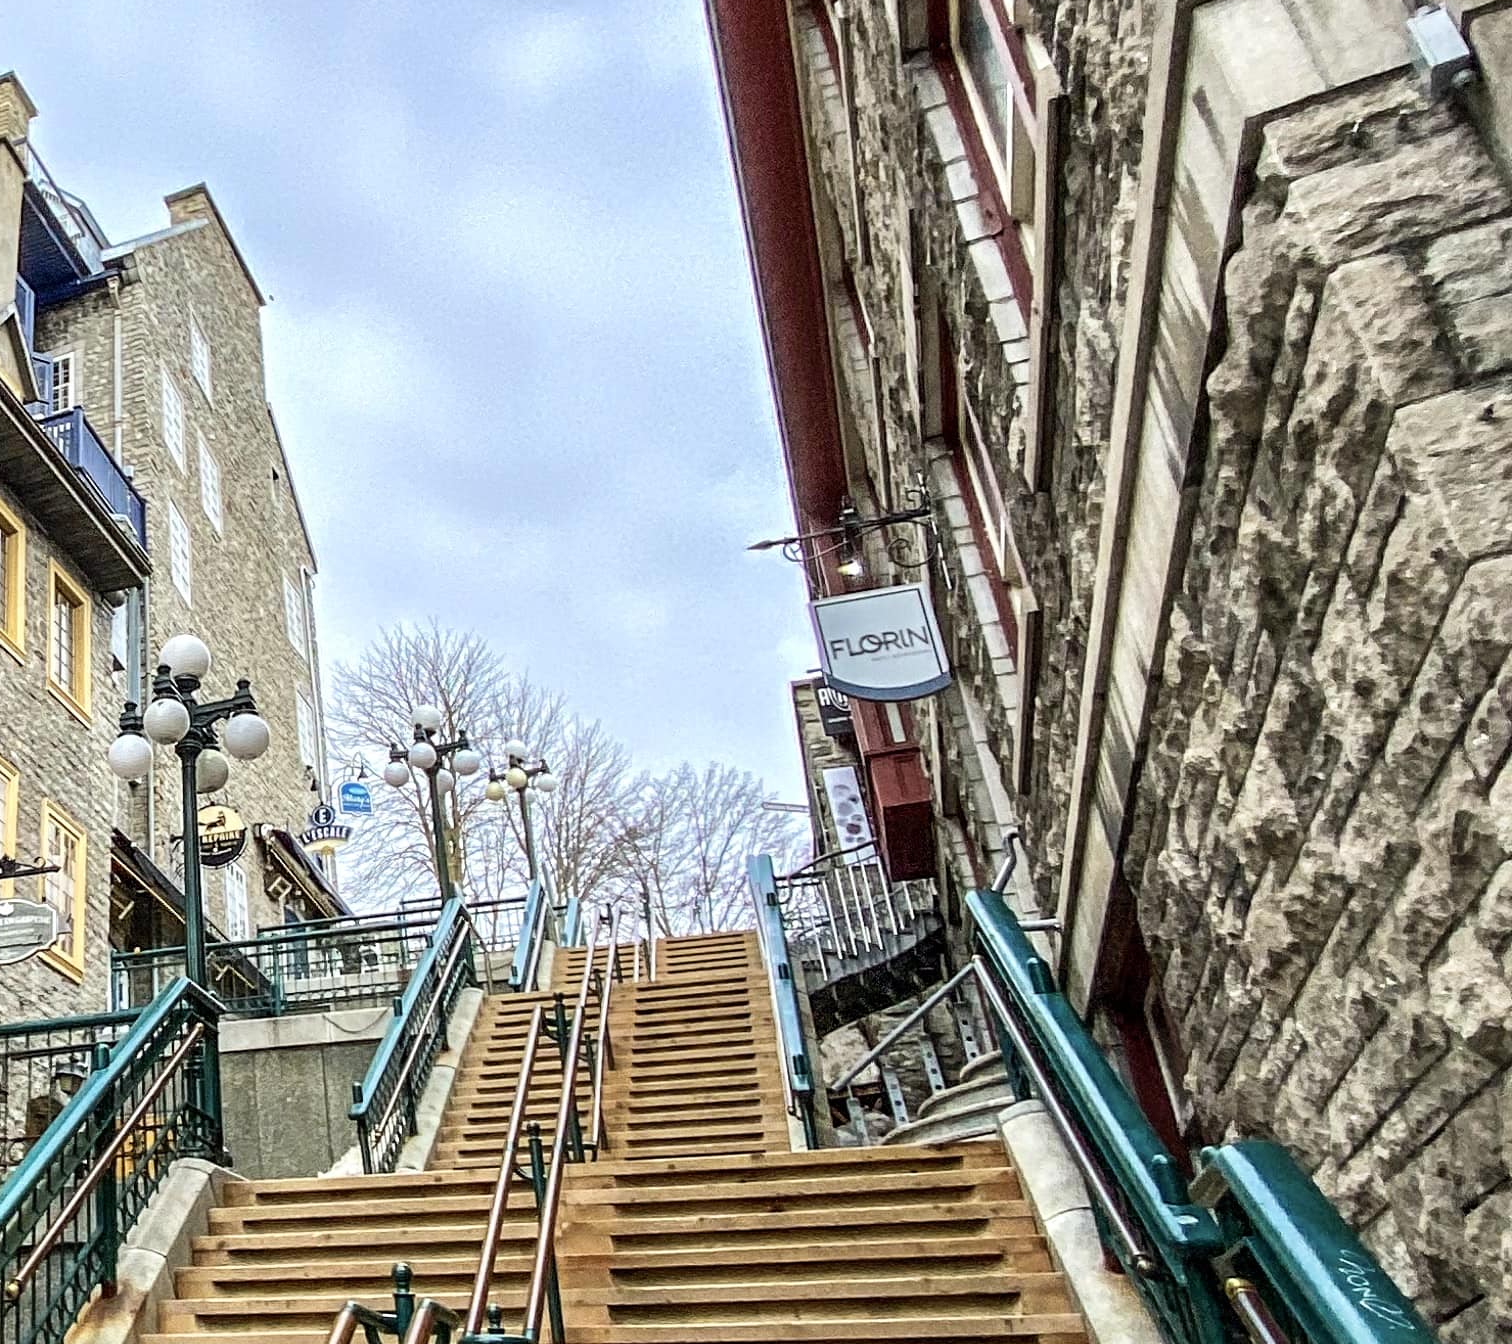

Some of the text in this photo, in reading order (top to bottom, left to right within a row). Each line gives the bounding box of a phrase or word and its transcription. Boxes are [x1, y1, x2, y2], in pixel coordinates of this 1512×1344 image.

[828, 625, 931, 660] FLORIN
[318, 808, 327, 824] E
[301, 826, 348, 844] L'ESCALE
